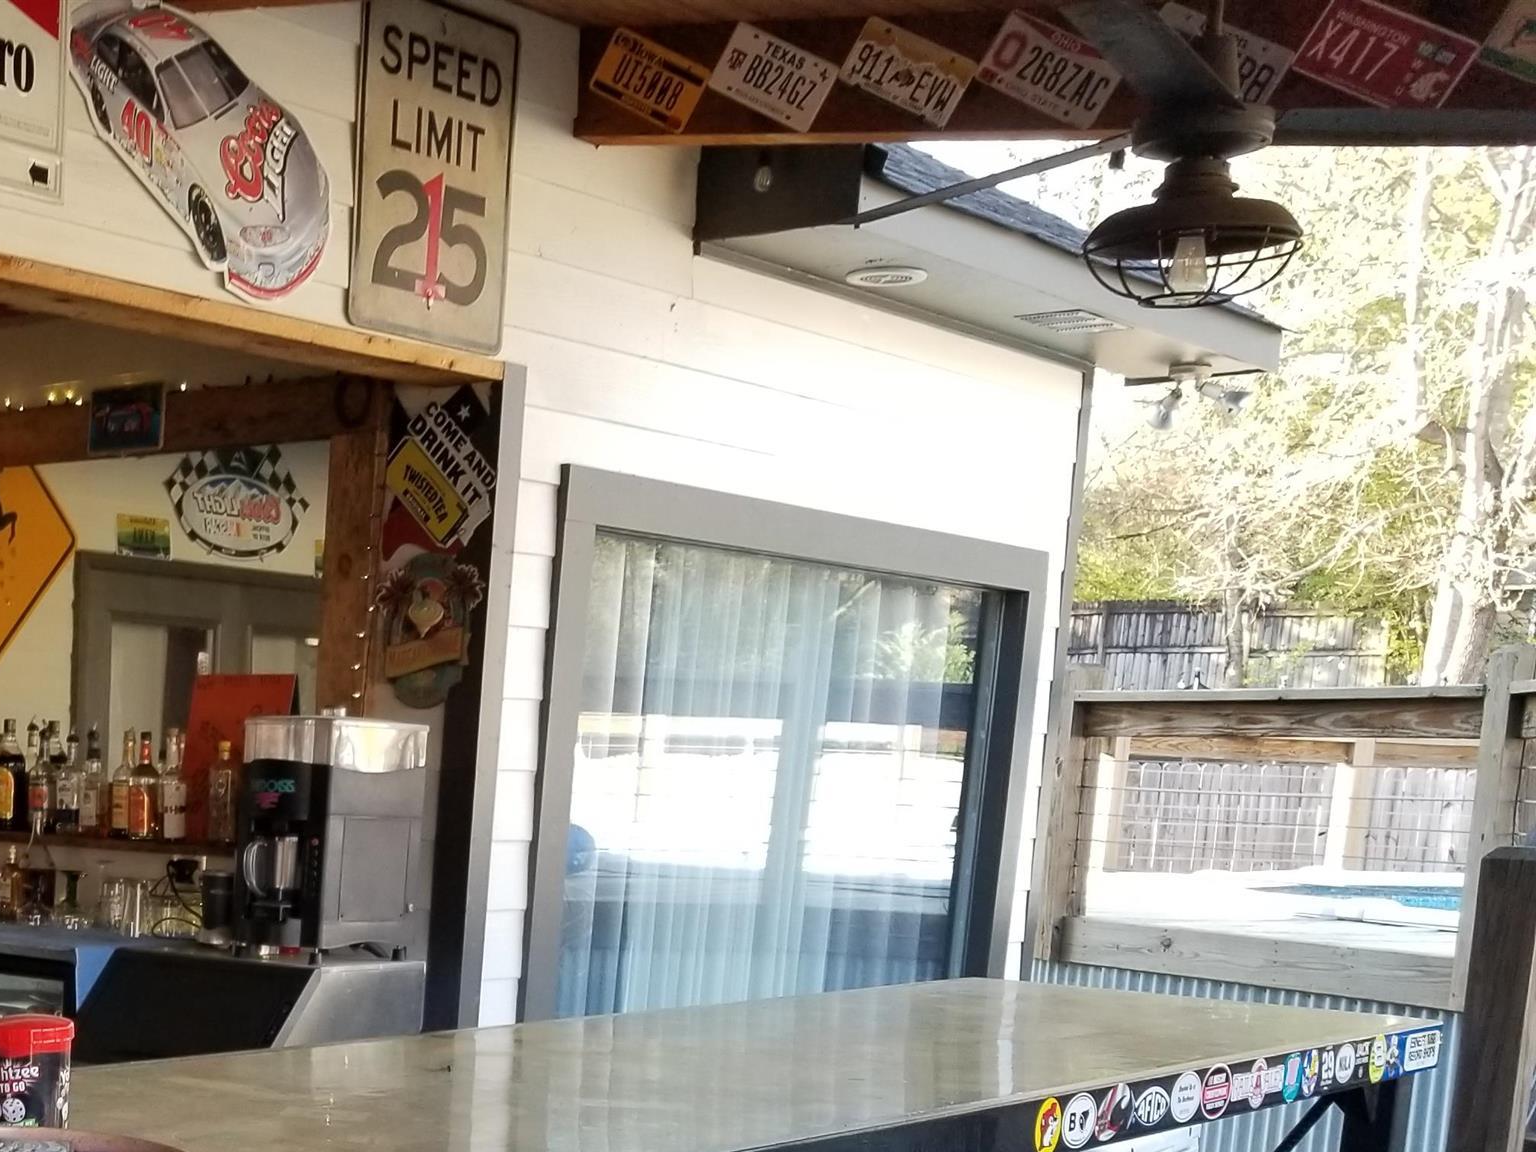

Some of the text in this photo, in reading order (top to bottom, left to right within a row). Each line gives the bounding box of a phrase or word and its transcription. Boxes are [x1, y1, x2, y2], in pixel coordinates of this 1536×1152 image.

[764, 41, 806, 70] TEXAS
[1051, 32, 1082, 52] OHIO
[1306, 20, 1400, 81] X417
[1336, 11, 1411, 45] WASHINGTON
[89, 55, 120, 95] LIGHT
[380, 24, 502, 107] SPEED
[853, 43, 895, 86] 911
[910, 70, 957, 112] EVW
[120, 98, 154, 166] 40
[390, 98, 485, 172] LIMIT
[412, 414, 467, 487] DRINK
[461, 482, 482, 507] IT
[426, 401, 496, 489] COME AND
[403, 464, 438, 502] TWISTED
[431, 498, 449, 524] TEA
[0, 1081, 26, 1094] TO GO
[1321, 1050, 1334, 1080] 29
